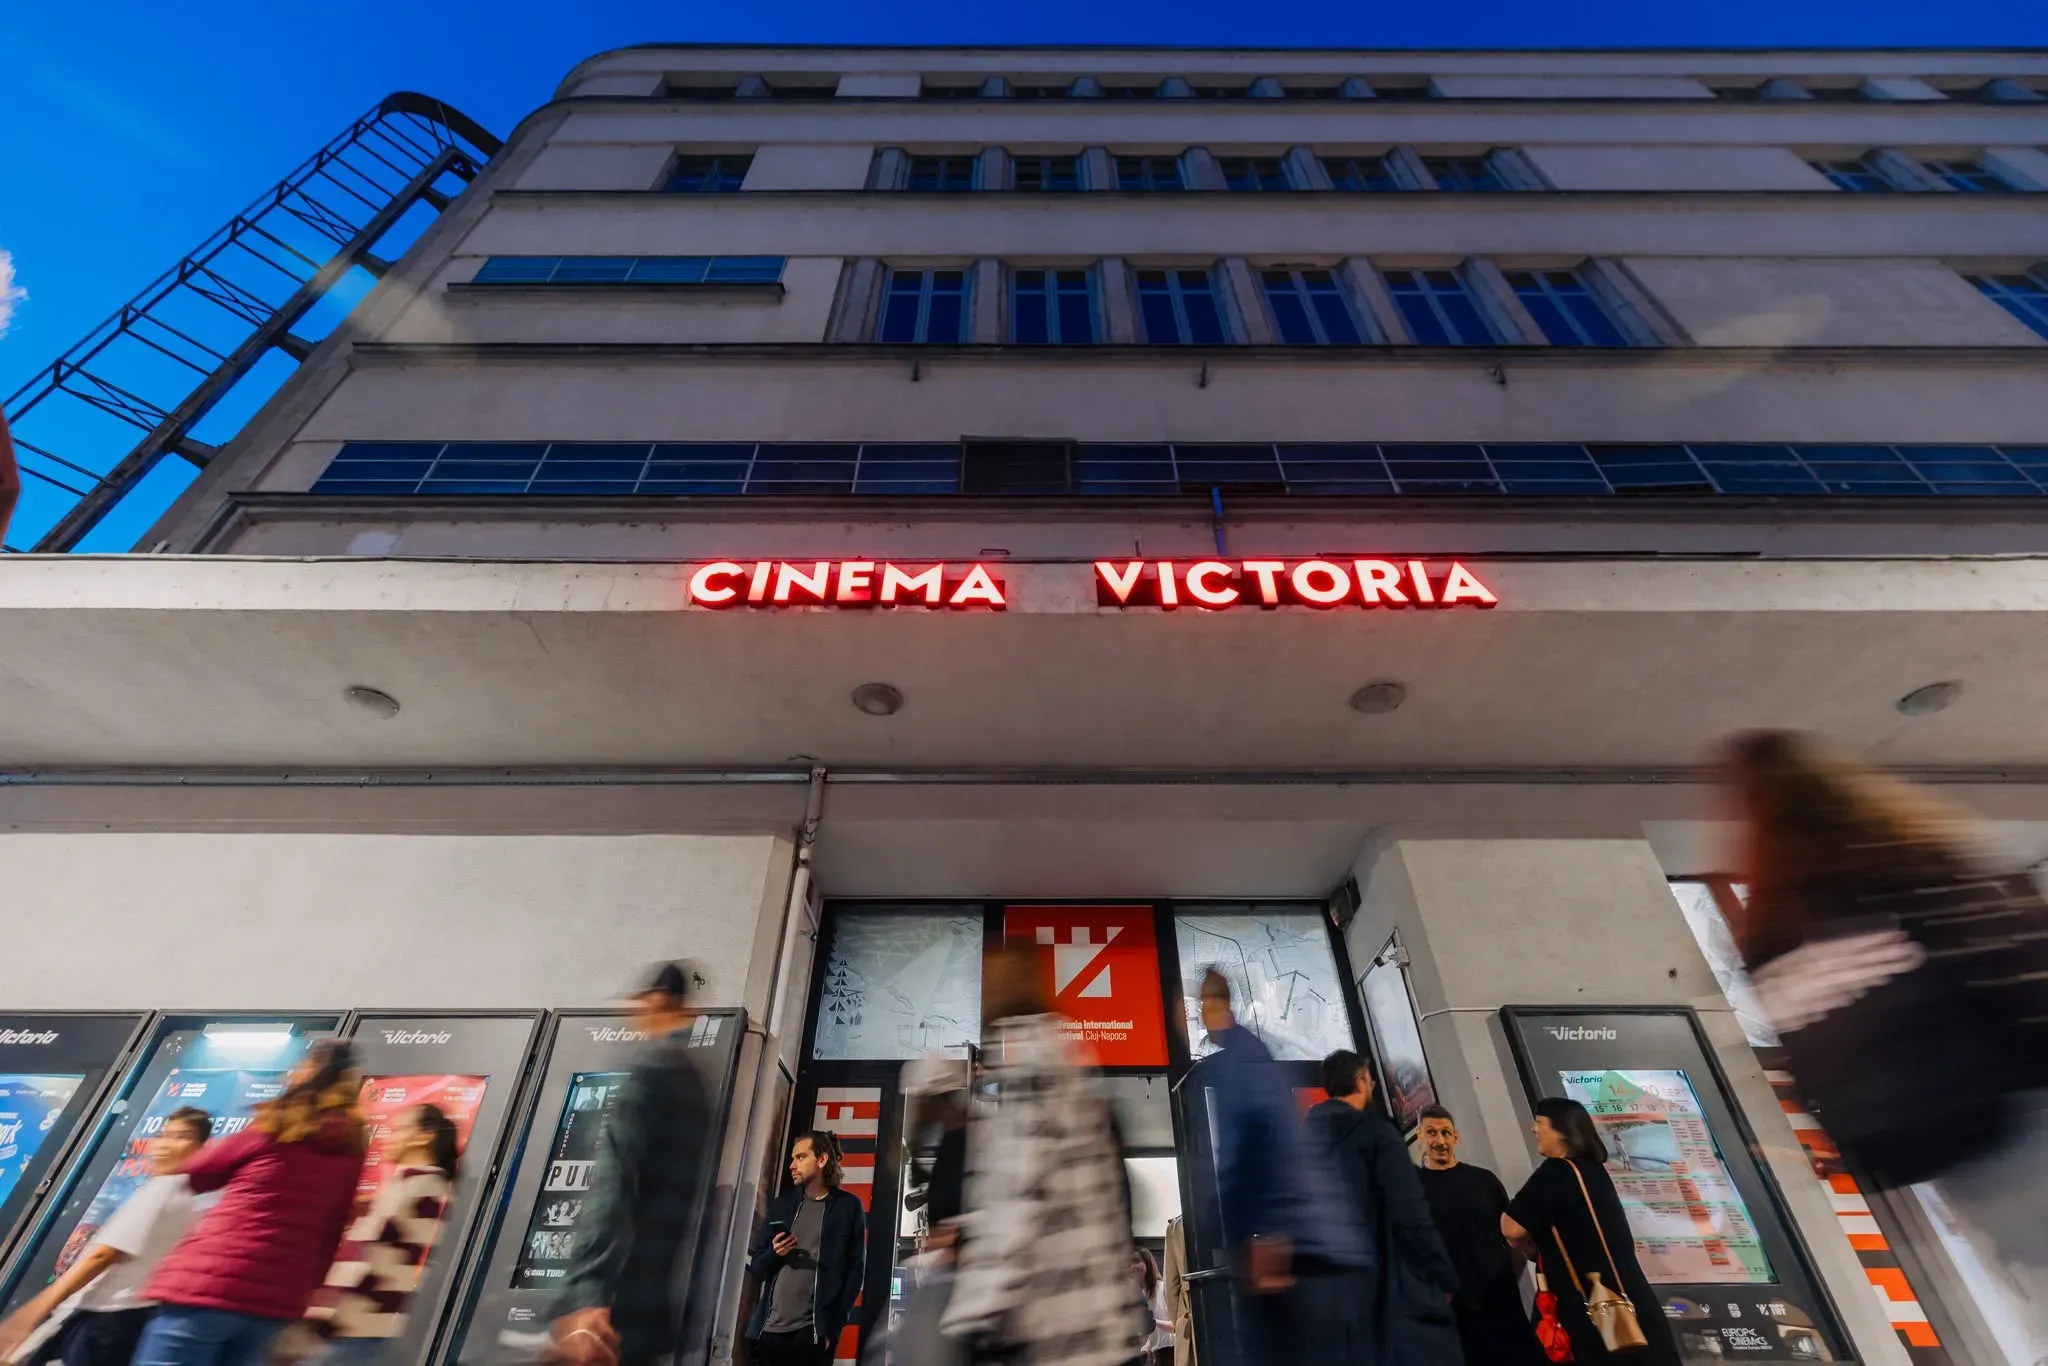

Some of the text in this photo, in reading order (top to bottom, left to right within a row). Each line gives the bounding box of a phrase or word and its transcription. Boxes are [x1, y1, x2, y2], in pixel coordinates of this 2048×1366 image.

[689, 559, 1499, 608] CINEMA VICTORIA
[1084, 1020, 1133, 1029] International
[384, 1029, 453, 1045] Victoria
[589, 1026, 650, 1042] Victori
[1056, 1030, 1127, 1042] estival Cluj-Napoca
[1550, 1026, 1617, 1041] Victoria
[1565, 1075, 1603, 1085] Victoria
[1608, 1084, 1626, 1097] 14
[1721, 1328, 1758, 1337] EUROPA
[1729, 1336, 1768, 1346] CINEMAS
